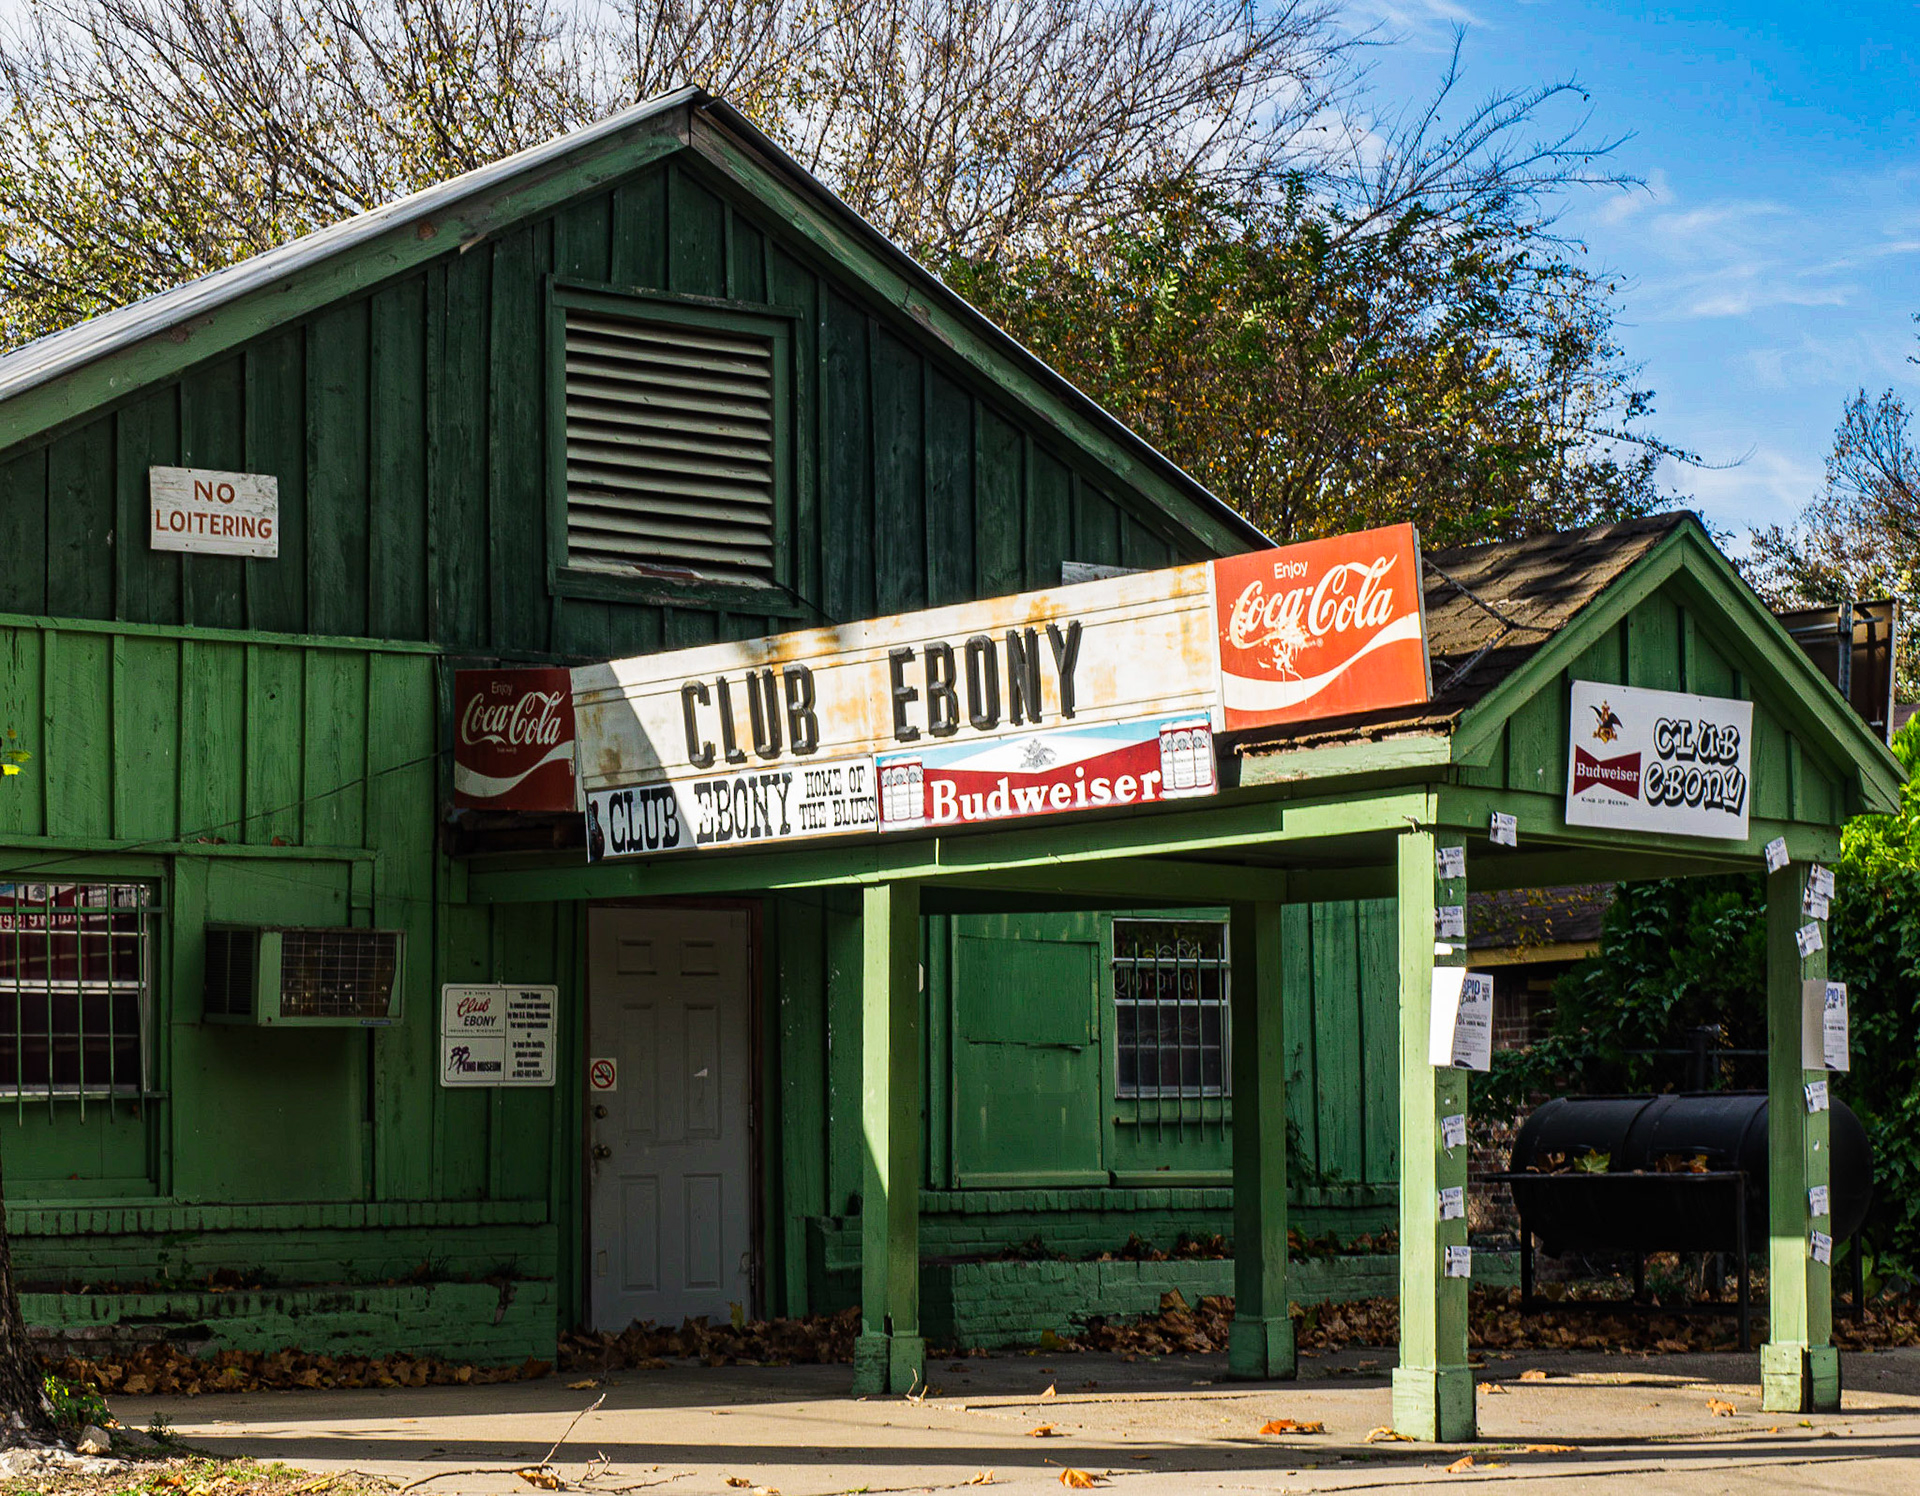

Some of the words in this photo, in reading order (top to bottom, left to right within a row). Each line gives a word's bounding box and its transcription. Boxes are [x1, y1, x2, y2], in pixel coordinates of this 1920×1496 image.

[194, 480, 235, 504] NO
[156, 509, 272, 539] LOITERING
[1273, 560, 1308, 580] Enjoy
[1229, 554, 1398, 649] Coca-Cola
[491, 681, 513, 695] Enjoy
[680, 663, 820, 769] CLUB
[888, 619, 1083, 743] EBONY
[461, 691, 566, 745] Coca-Cola
[1653, 717, 1740, 766] CLUB
[804, 768, 842, 799] HOME
[848, 765, 865, 794] OF
[1576, 762, 1639, 782] Budweiser
[930, 766, 1162, 824] Budweiser
[609, 785, 680, 853] CLUB
[694, 771, 793, 845] EBONY
[799, 802, 827, 830] THE
[833, 796, 876, 827] BLUES
[457, 997, 491, 1017] Club
[464, 1015, 497, 1026] EBONY
[477, 1061, 501, 1072] MUSEUM
